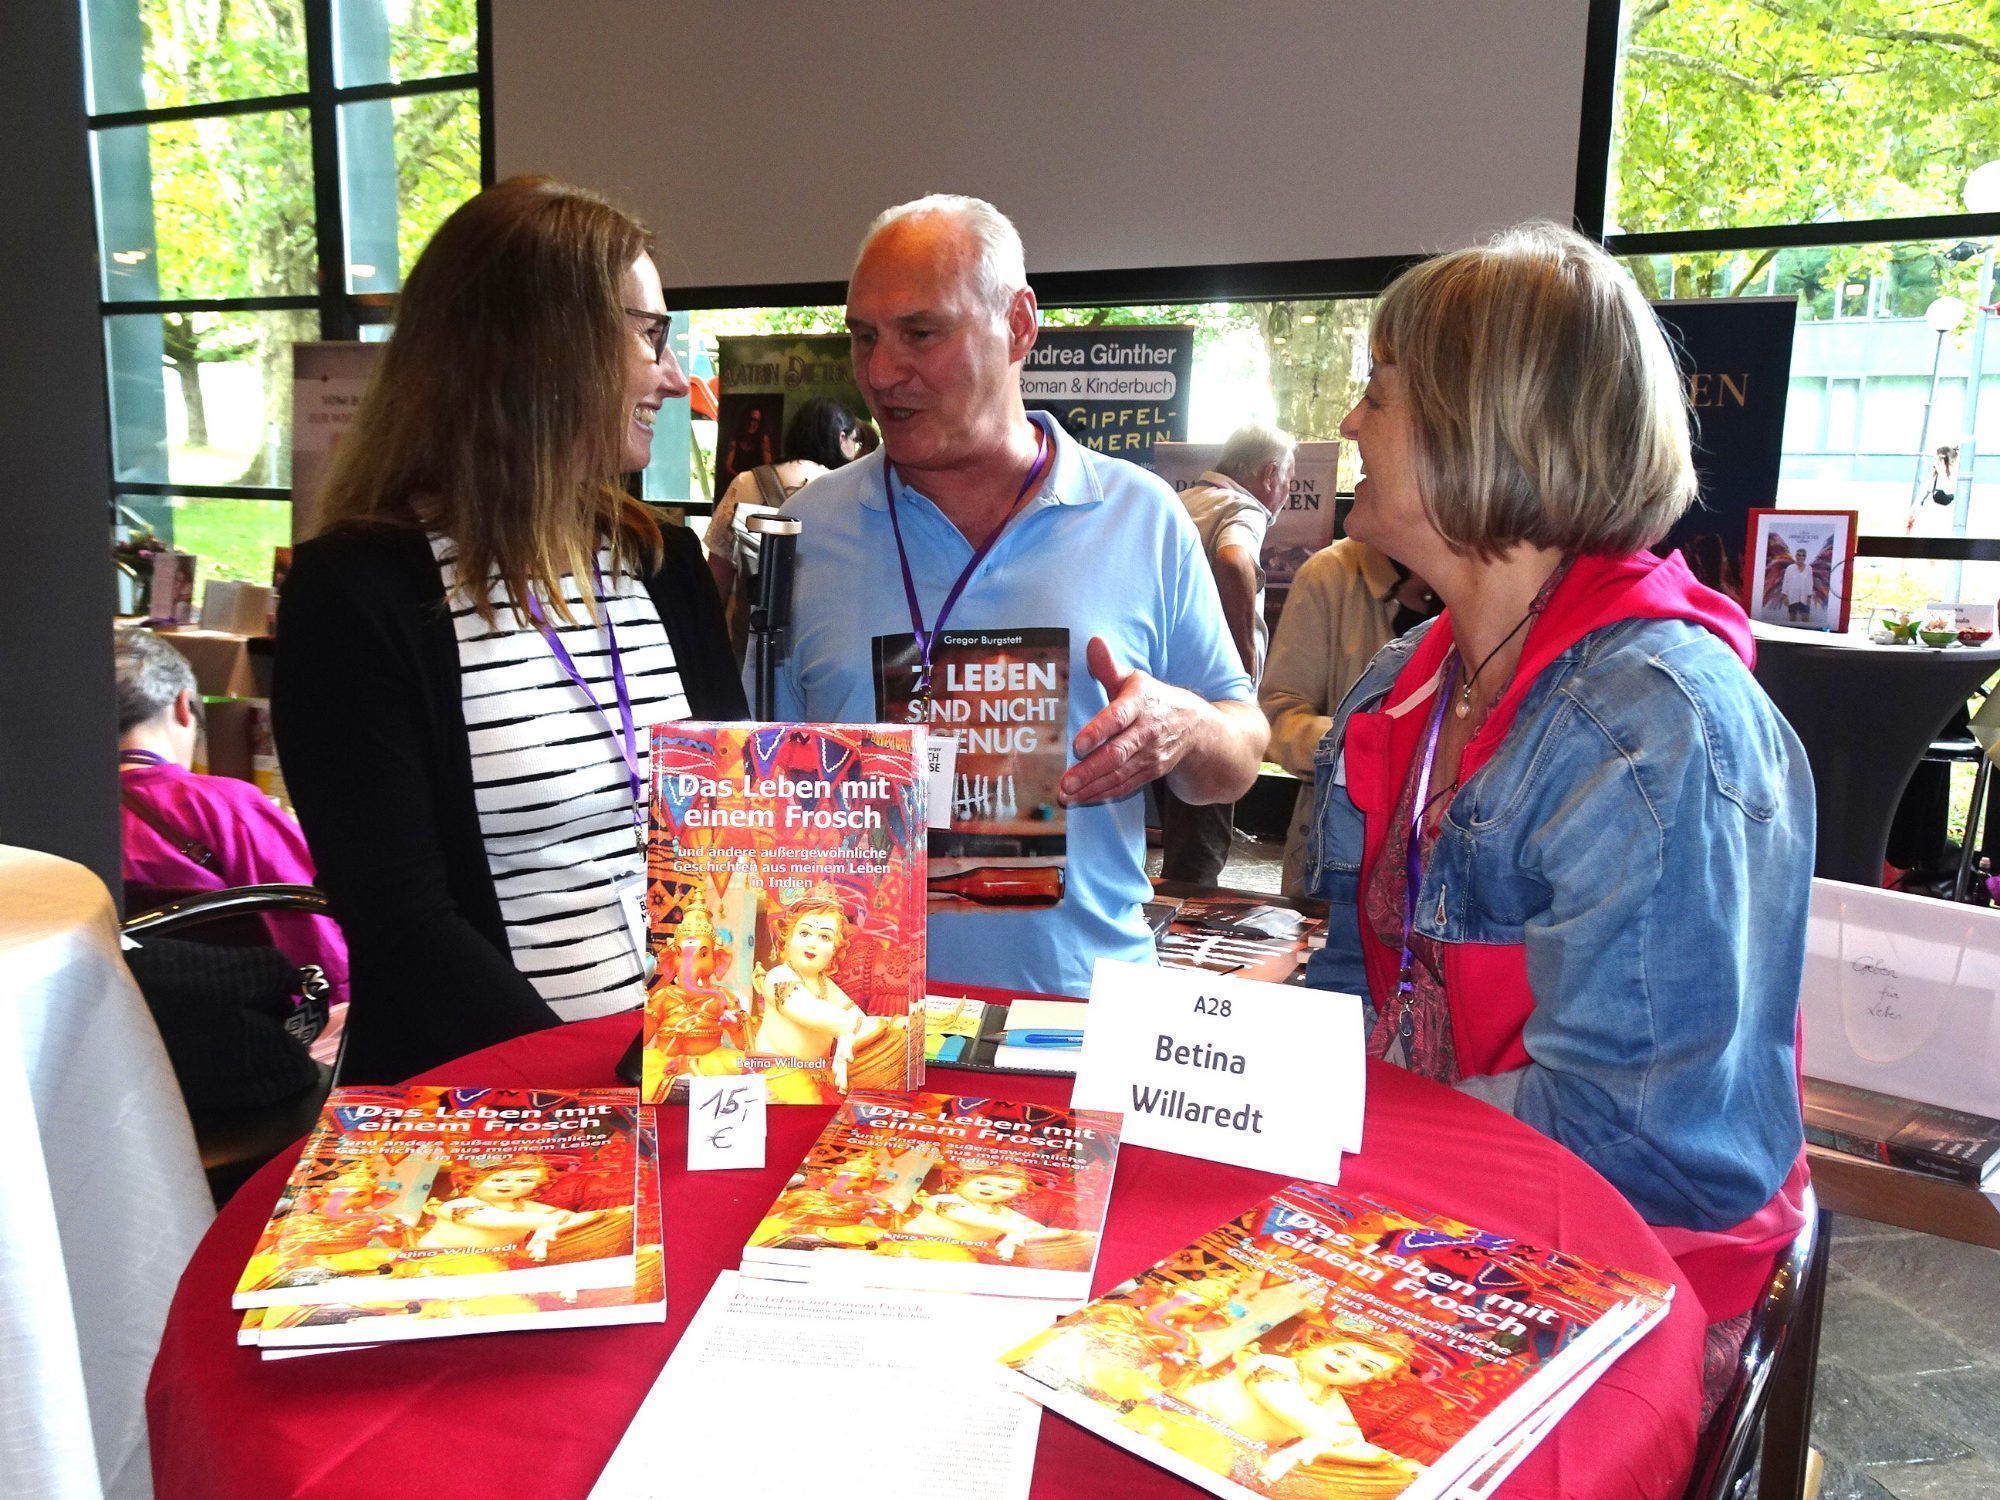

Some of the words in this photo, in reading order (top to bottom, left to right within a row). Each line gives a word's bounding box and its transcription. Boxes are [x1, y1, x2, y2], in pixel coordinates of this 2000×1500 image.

[1023, 344, 1085, 365] ndrea
[1090, 343, 1177, 365] Günther
[1019, 377, 1067, 394] Roman
[1070, 377, 1082, 394] &
[1086, 376, 1173, 394] Kinderbuch
[1068, 406, 1177, 430] GIPFEL-
[1078, 430, 1171, 452] MERIN
[1288, 479, 1315, 493] ON
[1281, 493, 1321, 511] EN
[944, 635, 978, 646] Gregor
[981, 635, 1022, 646] Burgstett
[946, 663, 1056, 692] LEBEN
[907, 699, 971, 723] SND
[980, 698, 1059, 723] NICHT
[953, 726, 1038, 754] ENUG
[678, 774, 733, 798] Das
[743, 774, 832, 799] Leben
[842, 776, 891, 800] mit
[684, 803, 774, 828] einem
[785, 804, 881, 829] Frosch
[678, 847, 704, 858] und
[708, 847, 756, 858] andere
[760, 846, 887, 861] außergewöhnliche
[673, 860, 758, 873] Geschichten
[762, 864, 787, 874] aus
[790, 863, 845, 874] meinem
[849, 862, 891, 874] Leben
[751, 877, 764, 888] in
[768, 876, 813, 889] Indien
[1193, 996, 1232, 1017] A28
[736, 1057, 771, 1069] Betina
[775, 1056, 826, 1069] Willaredt
[1155, 1034, 1246, 1075] Betina
[355, 1105, 421, 1118] Das
[435, 1106, 541, 1119] Leben
[554, 1104, 612, 1117] mit
[1132, 1084, 1264, 1134] Willaredt
[357, 1120, 469, 1132] einem
[484, 1117, 600, 1132] Frosch
[869, 1105, 927, 1121] Das
[938, 1112, 1032, 1132] Leben
[1043, 1125, 1097, 1140] mit
[342, 1139, 379, 1148] und
[384, 1139, 444, 1147] andere
[449, 1133, 607, 1147] außergewöhnliche
[705, 1126, 734, 1149] €
[869, 1119, 966, 1138] einem
[978, 1129, 1084, 1151] Frosch
[335, 1146, 444, 1155] Geschichten
[450, 1146, 481, 1155] aus
[486, 1143, 555, 1153] meinem
[560, 1139, 612, 1150] Leben
[456, 1152, 513, 1162] Indien
[855, 1133, 884, 1141] und
[889, 1136, 941, 1147] andere
[945, 1142, 1087, 1164] außergewöhnliche
[945, 1149, 972, 1158] aus
[977, 1152, 1038, 1165] meinem
[1043, 1159, 1090, 1171] Leben
[949, 1155, 999, 1166] Indien
[444, 1243, 518, 1257] Willaredt
[923, 1234, 989, 1248] Willaredt
[1286, 1212, 1355, 1248] Das
[1364, 1243, 1477, 1297] Leben
[1485, 1291, 1562, 1325] mit
[1273, 1230, 1384, 1283] einem
[1392, 1277, 1528, 1338] Frosch
[1276, 1258, 1338, 1288] andere
[1340, 1284, 1512, 1356] außergewöhnliche
[1328, 1301, 1389, 1333] Indien
[1330, 1293, 1364, 1312] aus
[1369, 1306, 1444, 1343] meinem
[1446, 1336, 1509, 1367] Leben
